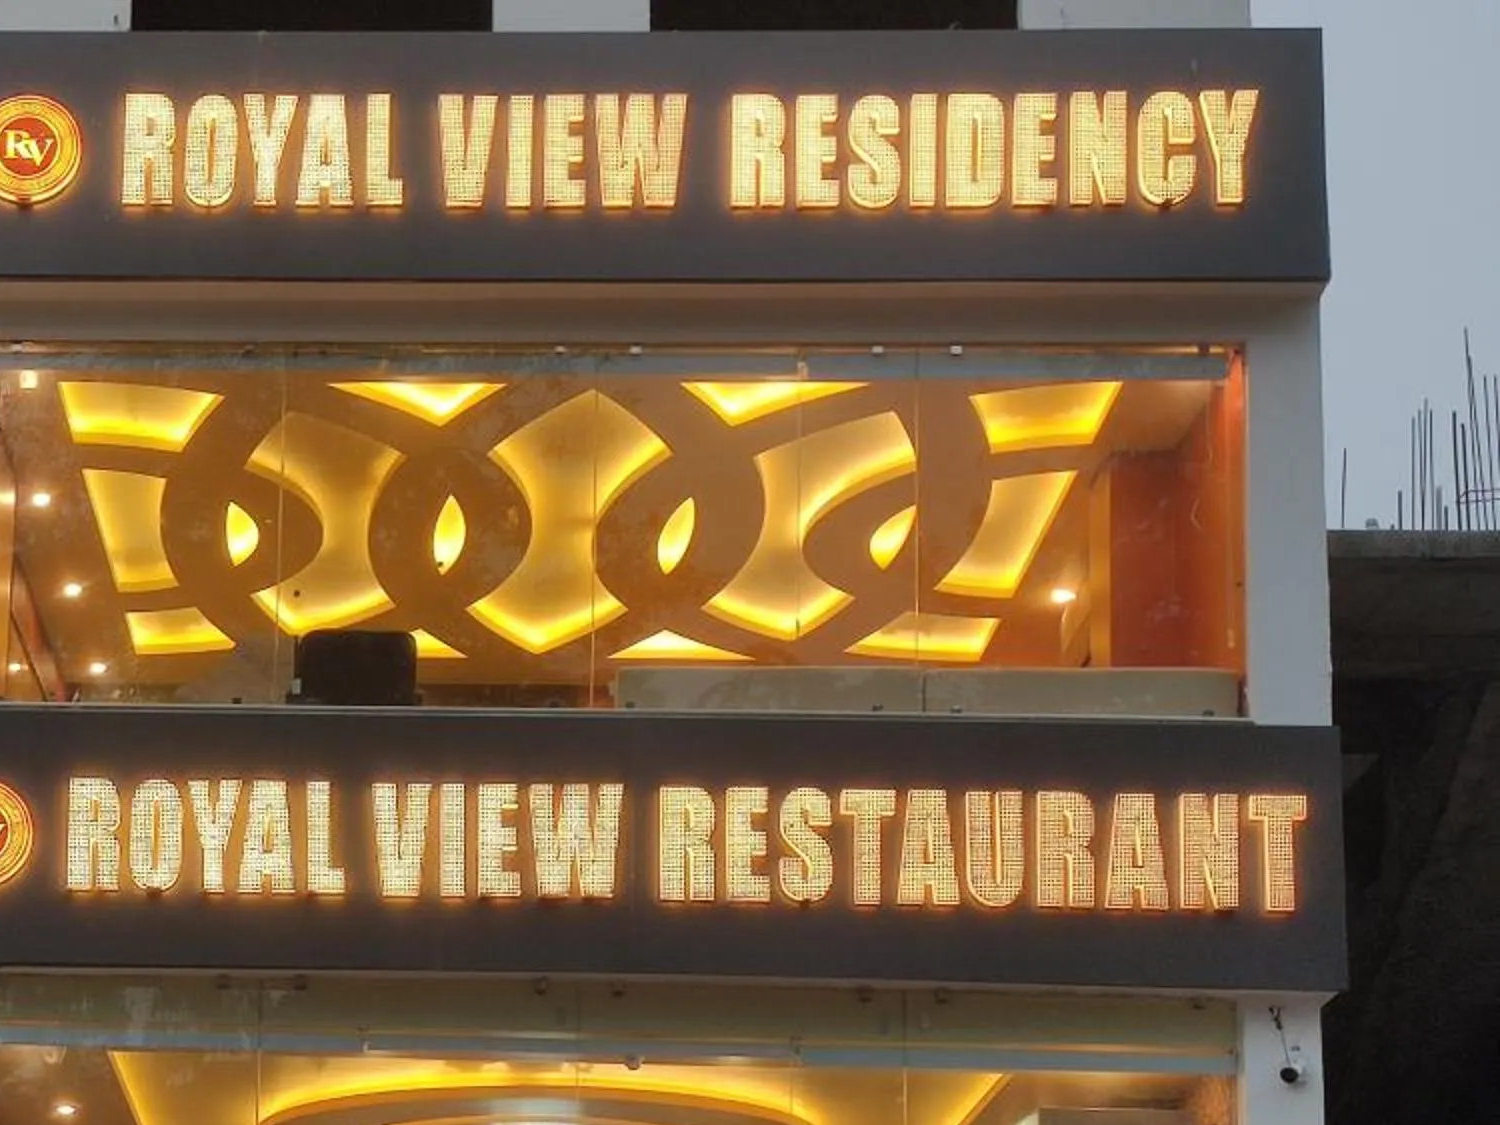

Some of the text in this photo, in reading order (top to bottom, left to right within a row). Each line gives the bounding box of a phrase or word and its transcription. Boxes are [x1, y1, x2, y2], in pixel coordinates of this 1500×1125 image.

[3, 128, 55, 167] RV
[121, 88, 1259, 208] ROYAL VIEW RESIDENCY
[65, 777, 1306, 912] ROYAL VIEW RESTAURANT
